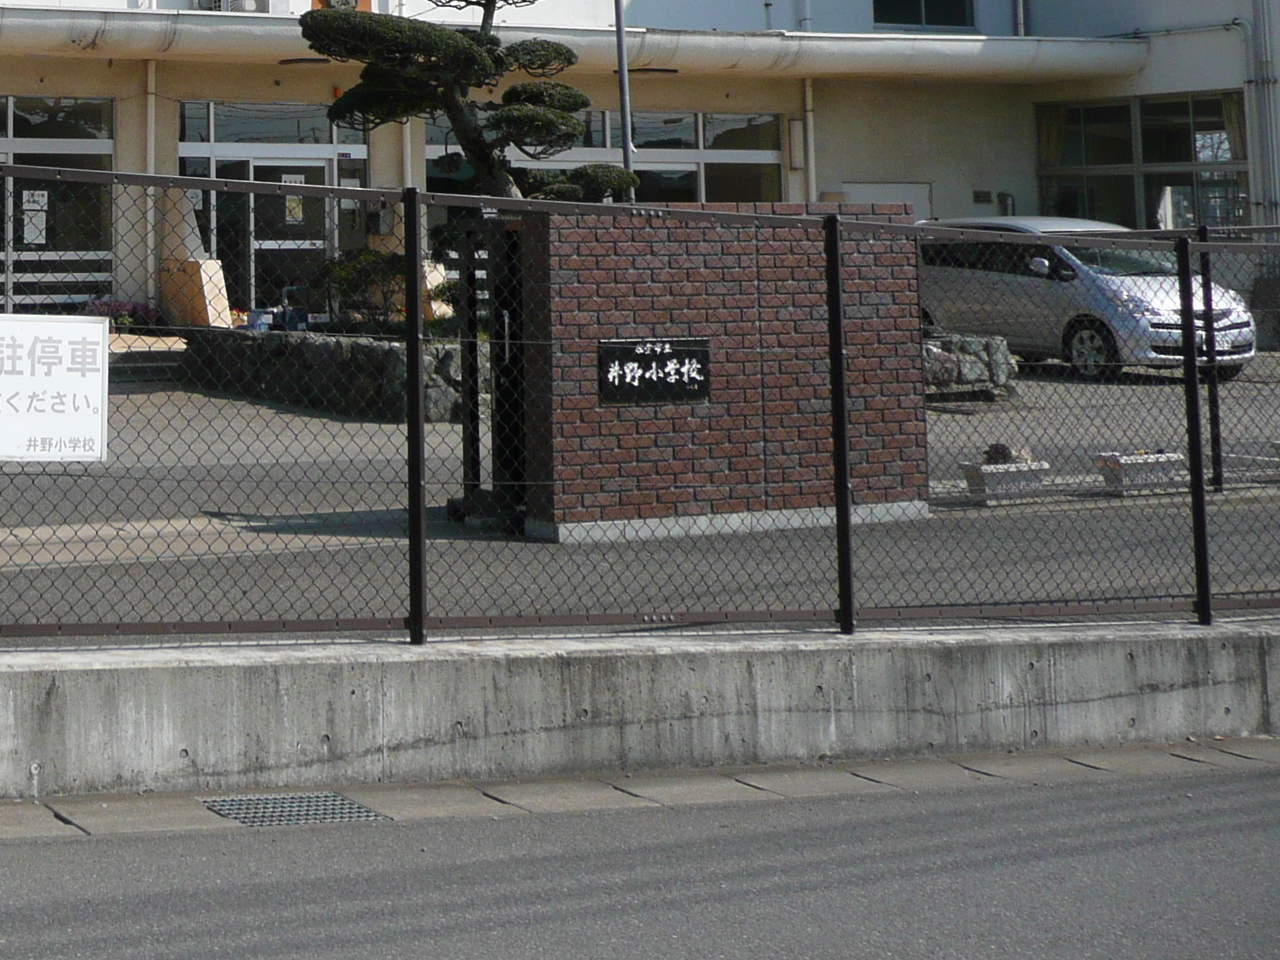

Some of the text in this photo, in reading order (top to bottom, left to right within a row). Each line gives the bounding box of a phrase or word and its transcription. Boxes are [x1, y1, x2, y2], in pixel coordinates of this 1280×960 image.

[607, 358, 704, 386] 井野小学校
[26, 437, 96, 453] 井野小学校
